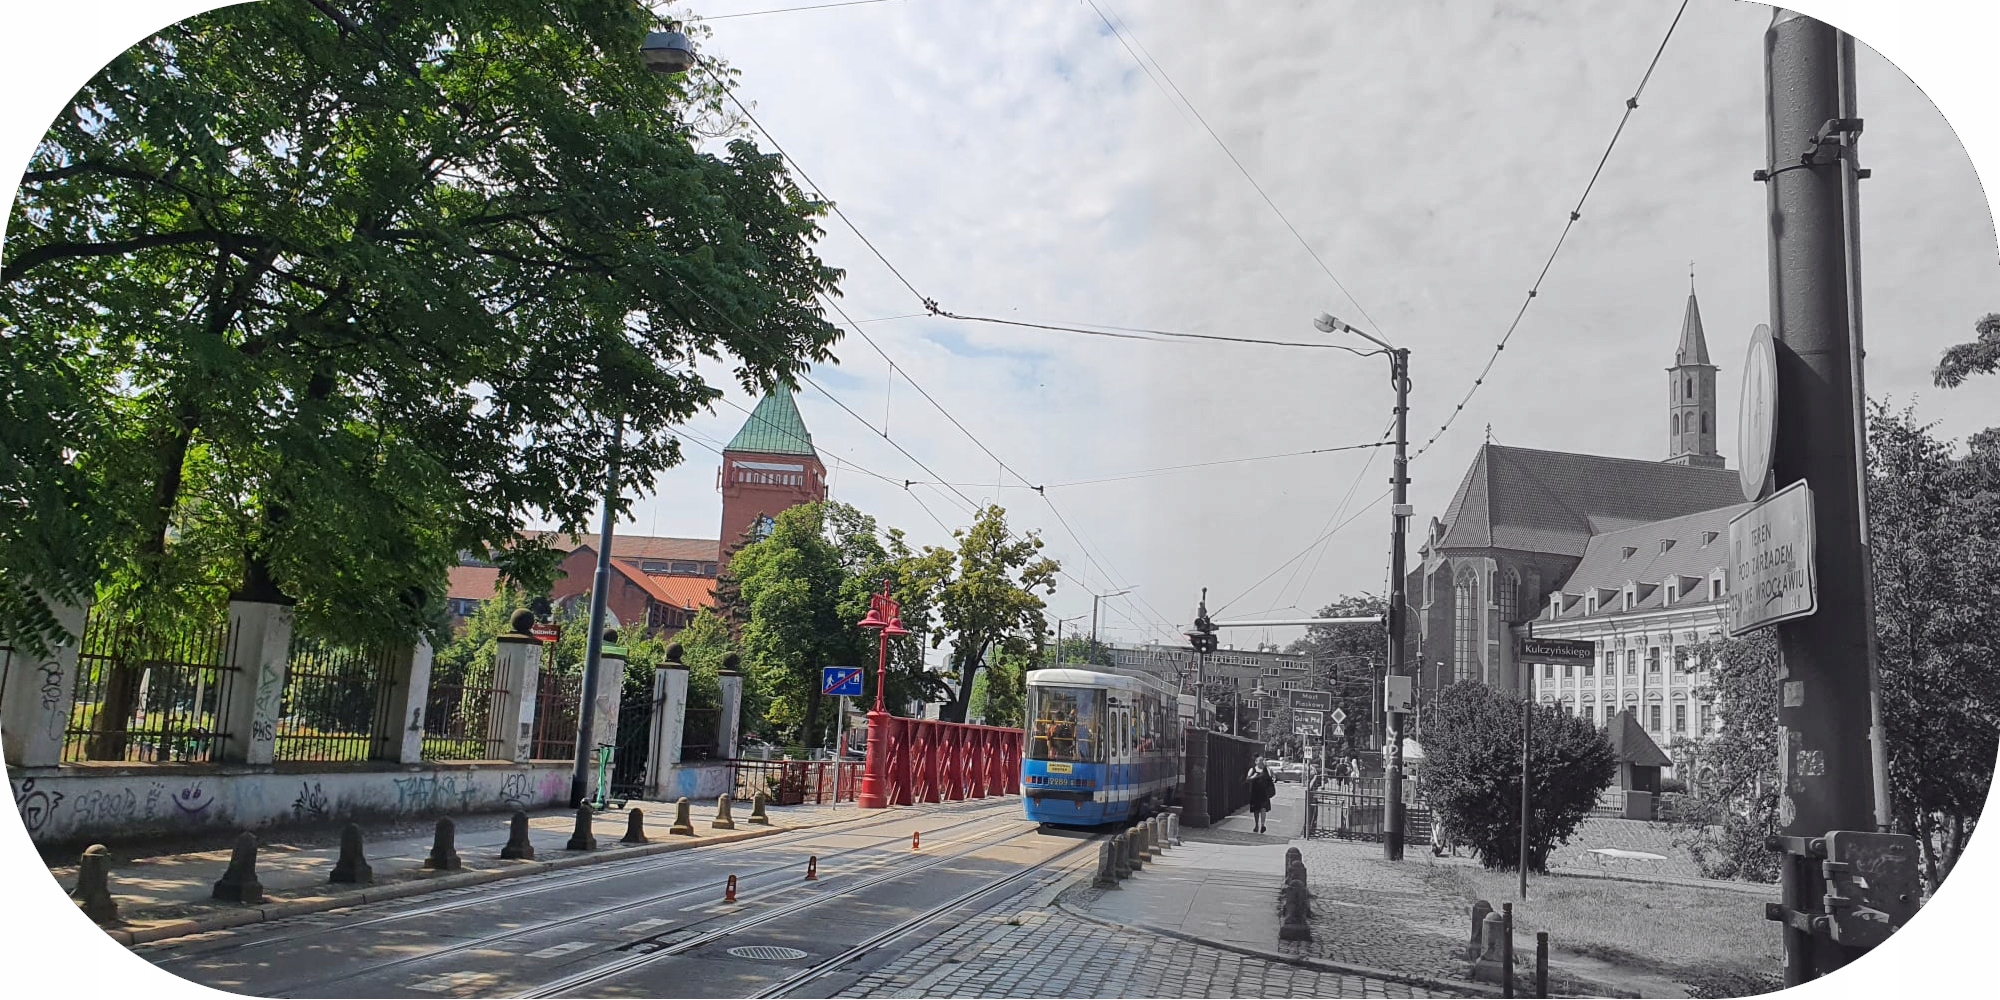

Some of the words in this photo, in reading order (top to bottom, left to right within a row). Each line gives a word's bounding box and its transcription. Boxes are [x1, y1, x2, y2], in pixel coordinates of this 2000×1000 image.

[1751, 522, 1772, 547] TEREN
[1738, 561, 1750, 582] POD
[1744, 587, 1753, 605] WE
[1756, 568, 1804, 601] WROCŁAWIU
[1525, 644, 1591, 659] Kulczyńskiego
